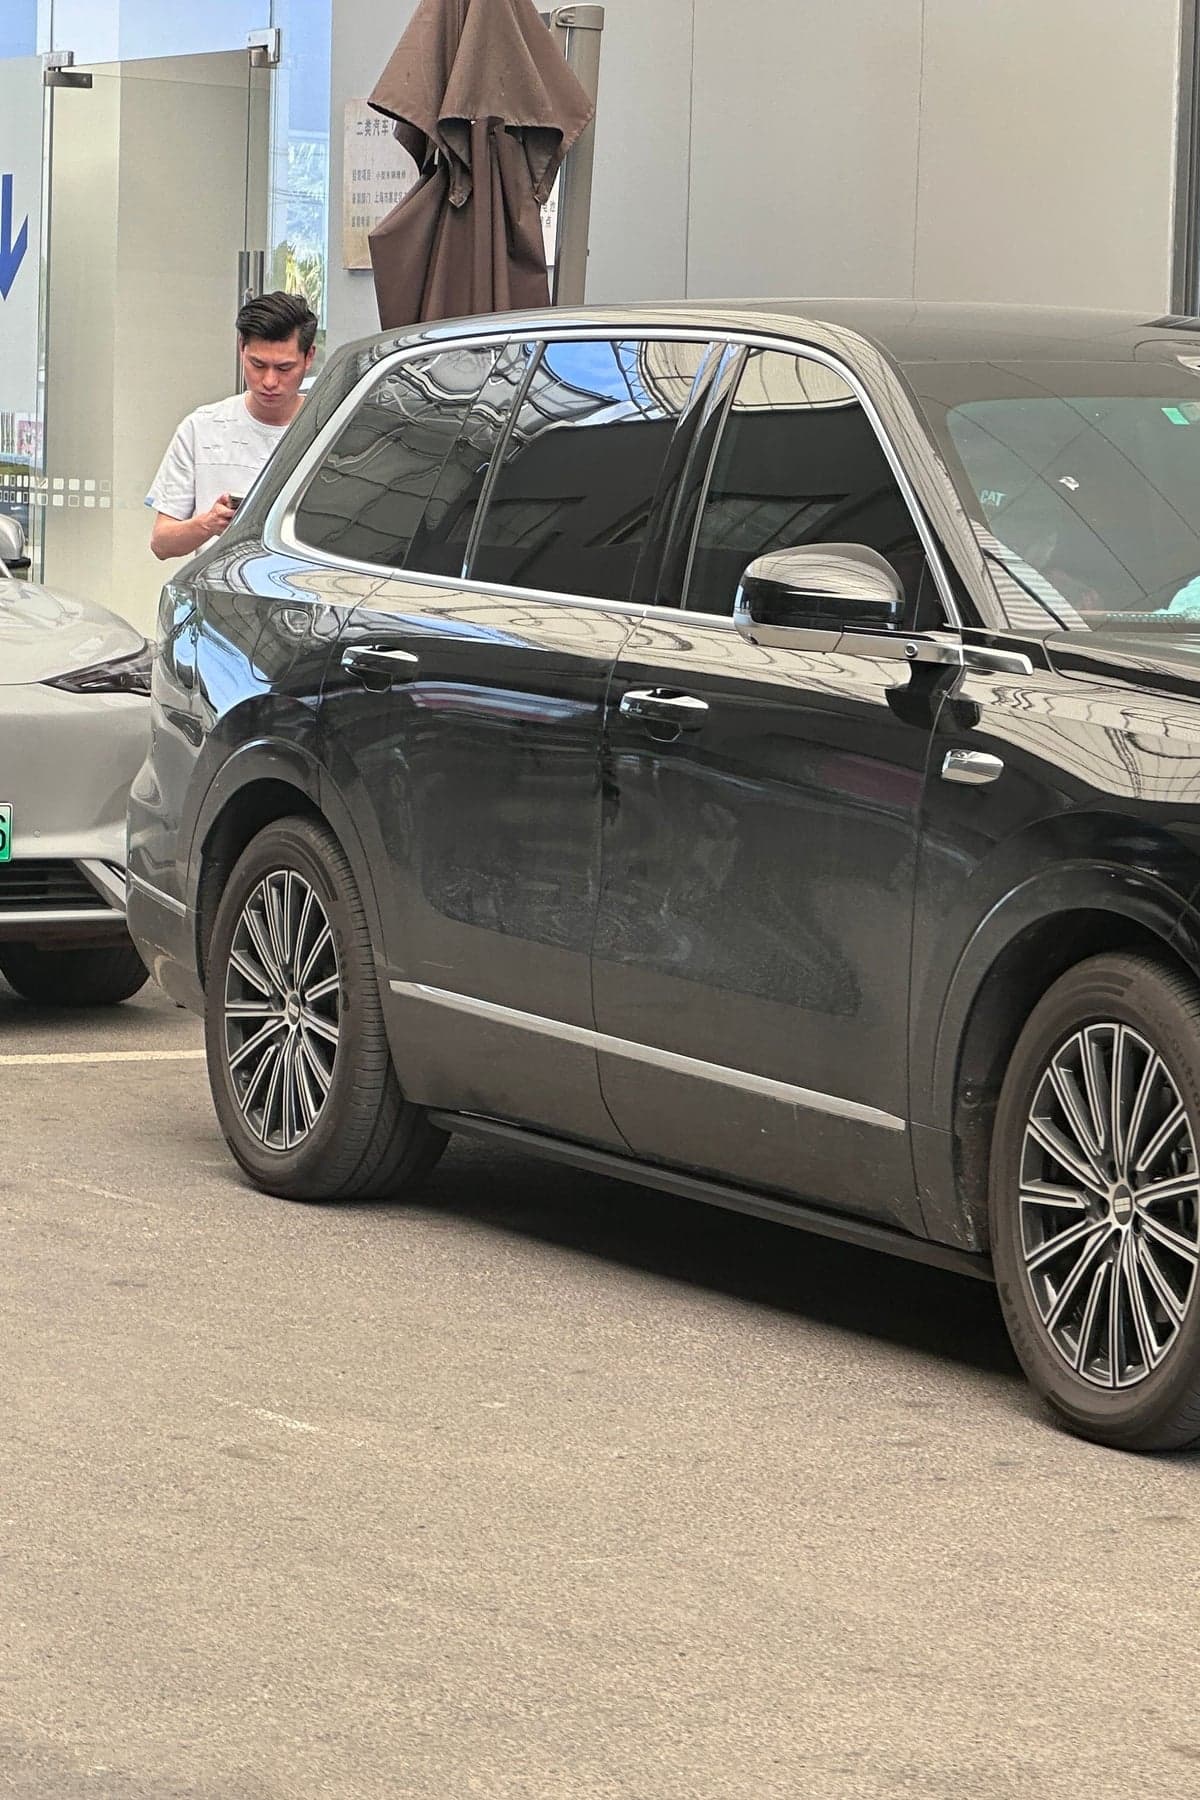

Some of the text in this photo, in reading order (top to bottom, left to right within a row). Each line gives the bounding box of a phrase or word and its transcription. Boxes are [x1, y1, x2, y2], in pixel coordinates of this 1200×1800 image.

[356, 118, 394, 136] 二类汽车
[980, 489, 1007, 507] CAT
